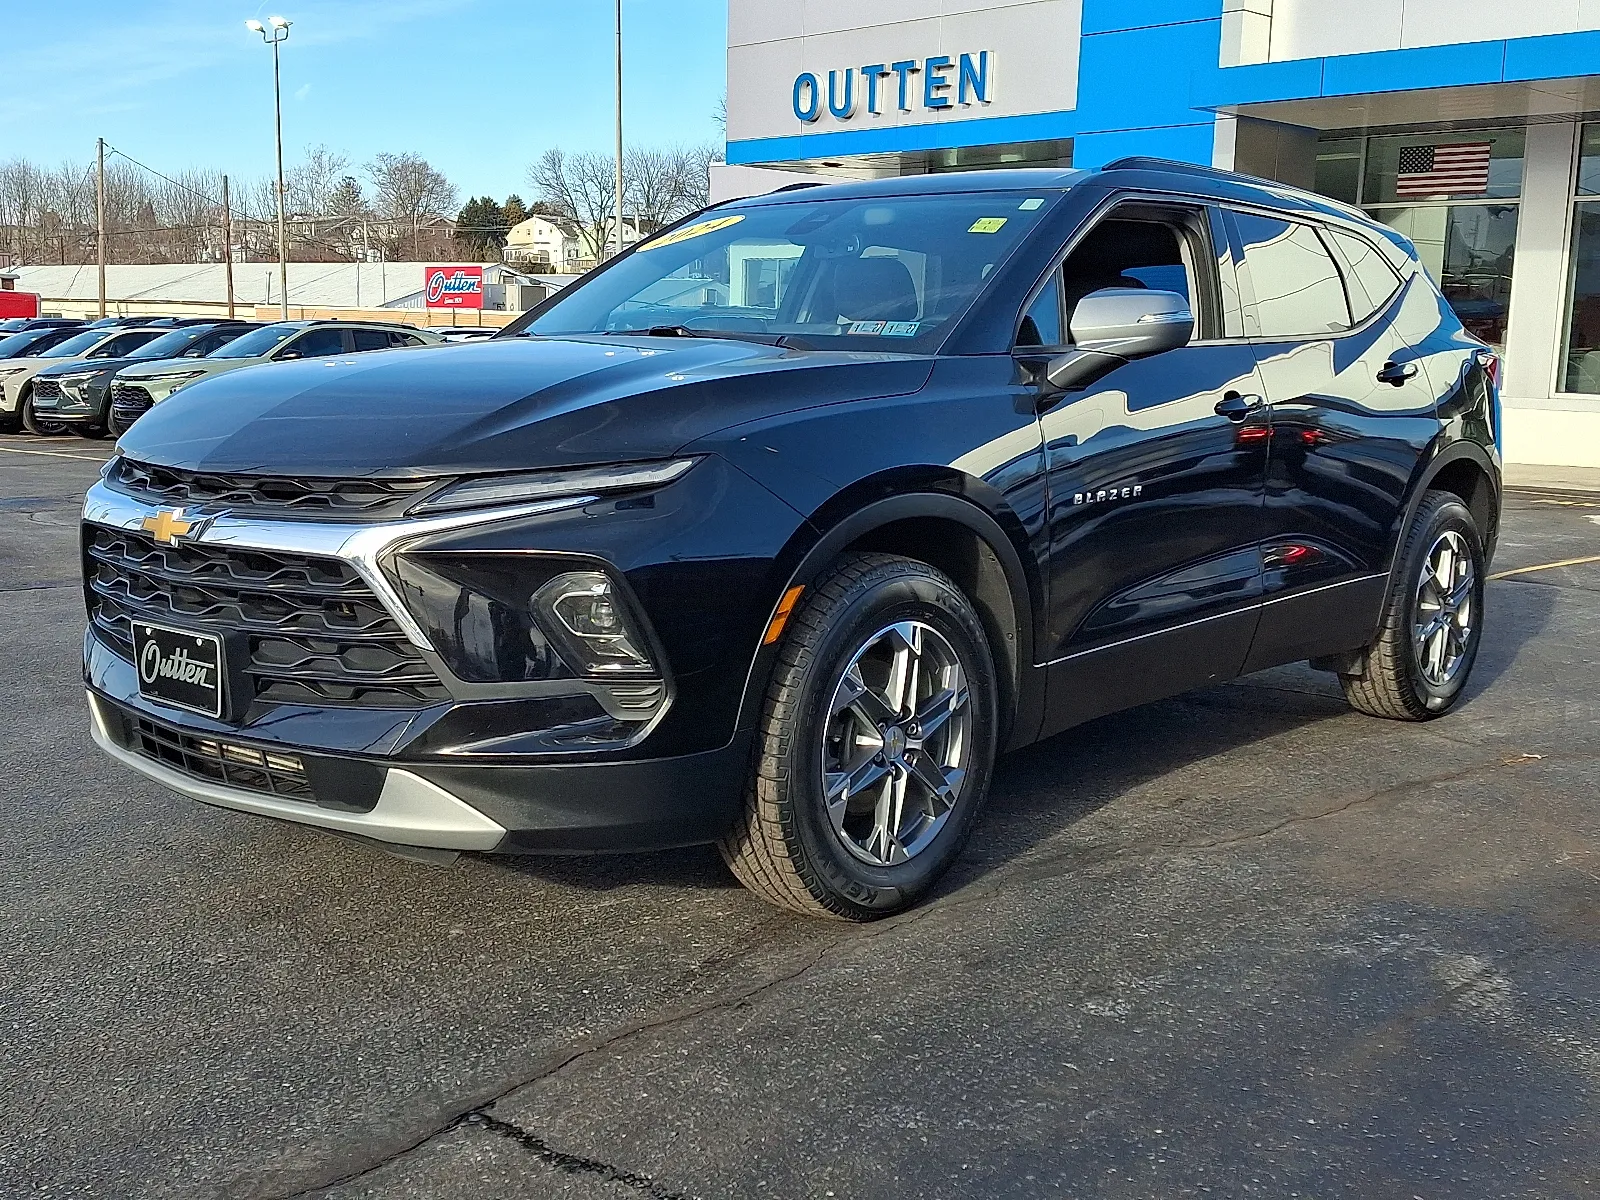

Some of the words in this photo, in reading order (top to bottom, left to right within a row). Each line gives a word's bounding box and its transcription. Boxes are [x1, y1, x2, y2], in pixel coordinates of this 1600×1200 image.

[792, 50, 993, 122] OUTTEN
[427, 271, 481, 302] Outten
[1073, 485, 1142, 505] BLAZER
[141, 640, 215, 689] Outten
